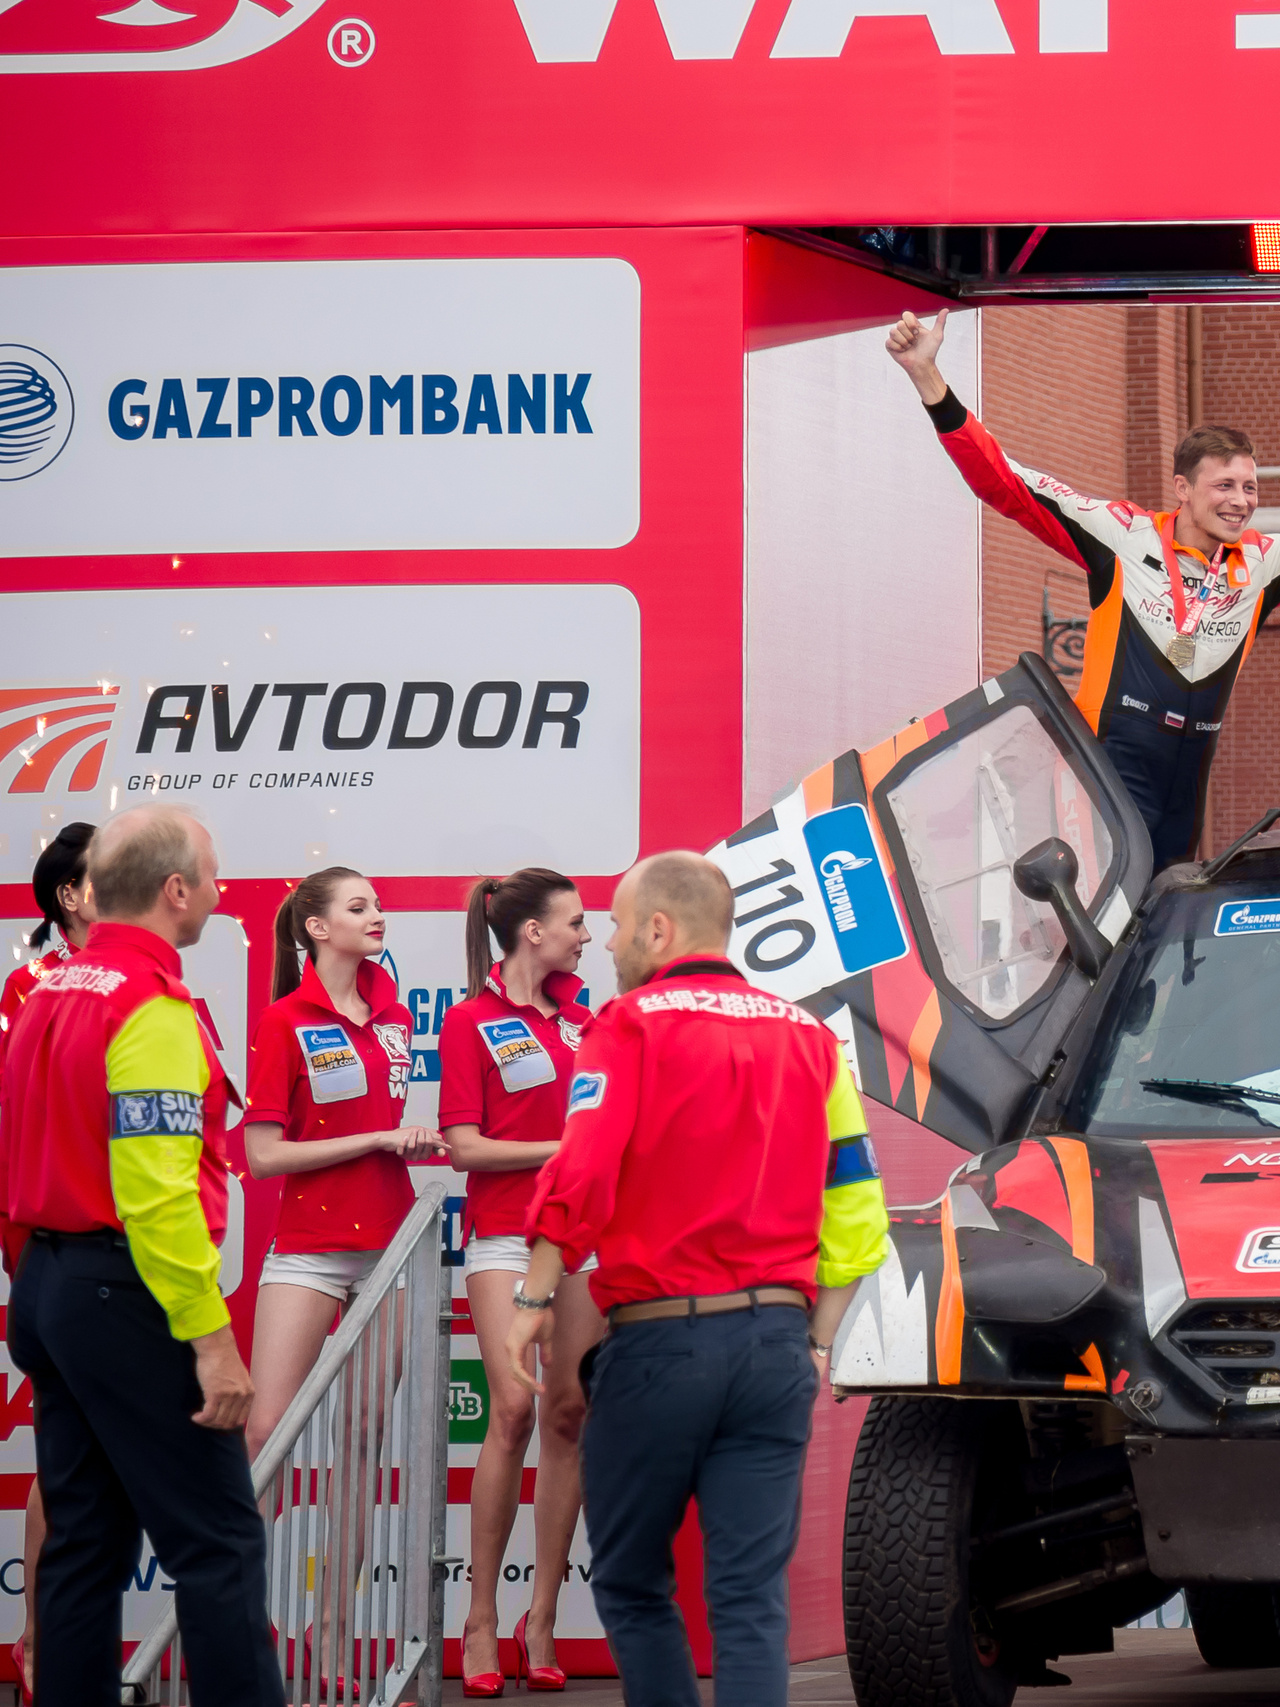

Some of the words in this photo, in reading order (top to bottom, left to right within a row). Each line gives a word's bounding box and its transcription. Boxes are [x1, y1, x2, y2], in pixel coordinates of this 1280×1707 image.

[107, 372, 595, 441] GAZPROMBANK
[1139, 598, 1164, 617] NG
[1197, 619, 1242, 636] NERGO
[135, 680, 590, 754] AVTODOR
[127, 773, 202, 791] GROUP
[212, 772, 239, 790] OF
[249, 771, 375, 789] COMPANIES
[732, 858, 816, 972] 110
[824, 874, 858, 933] GAZPROM
